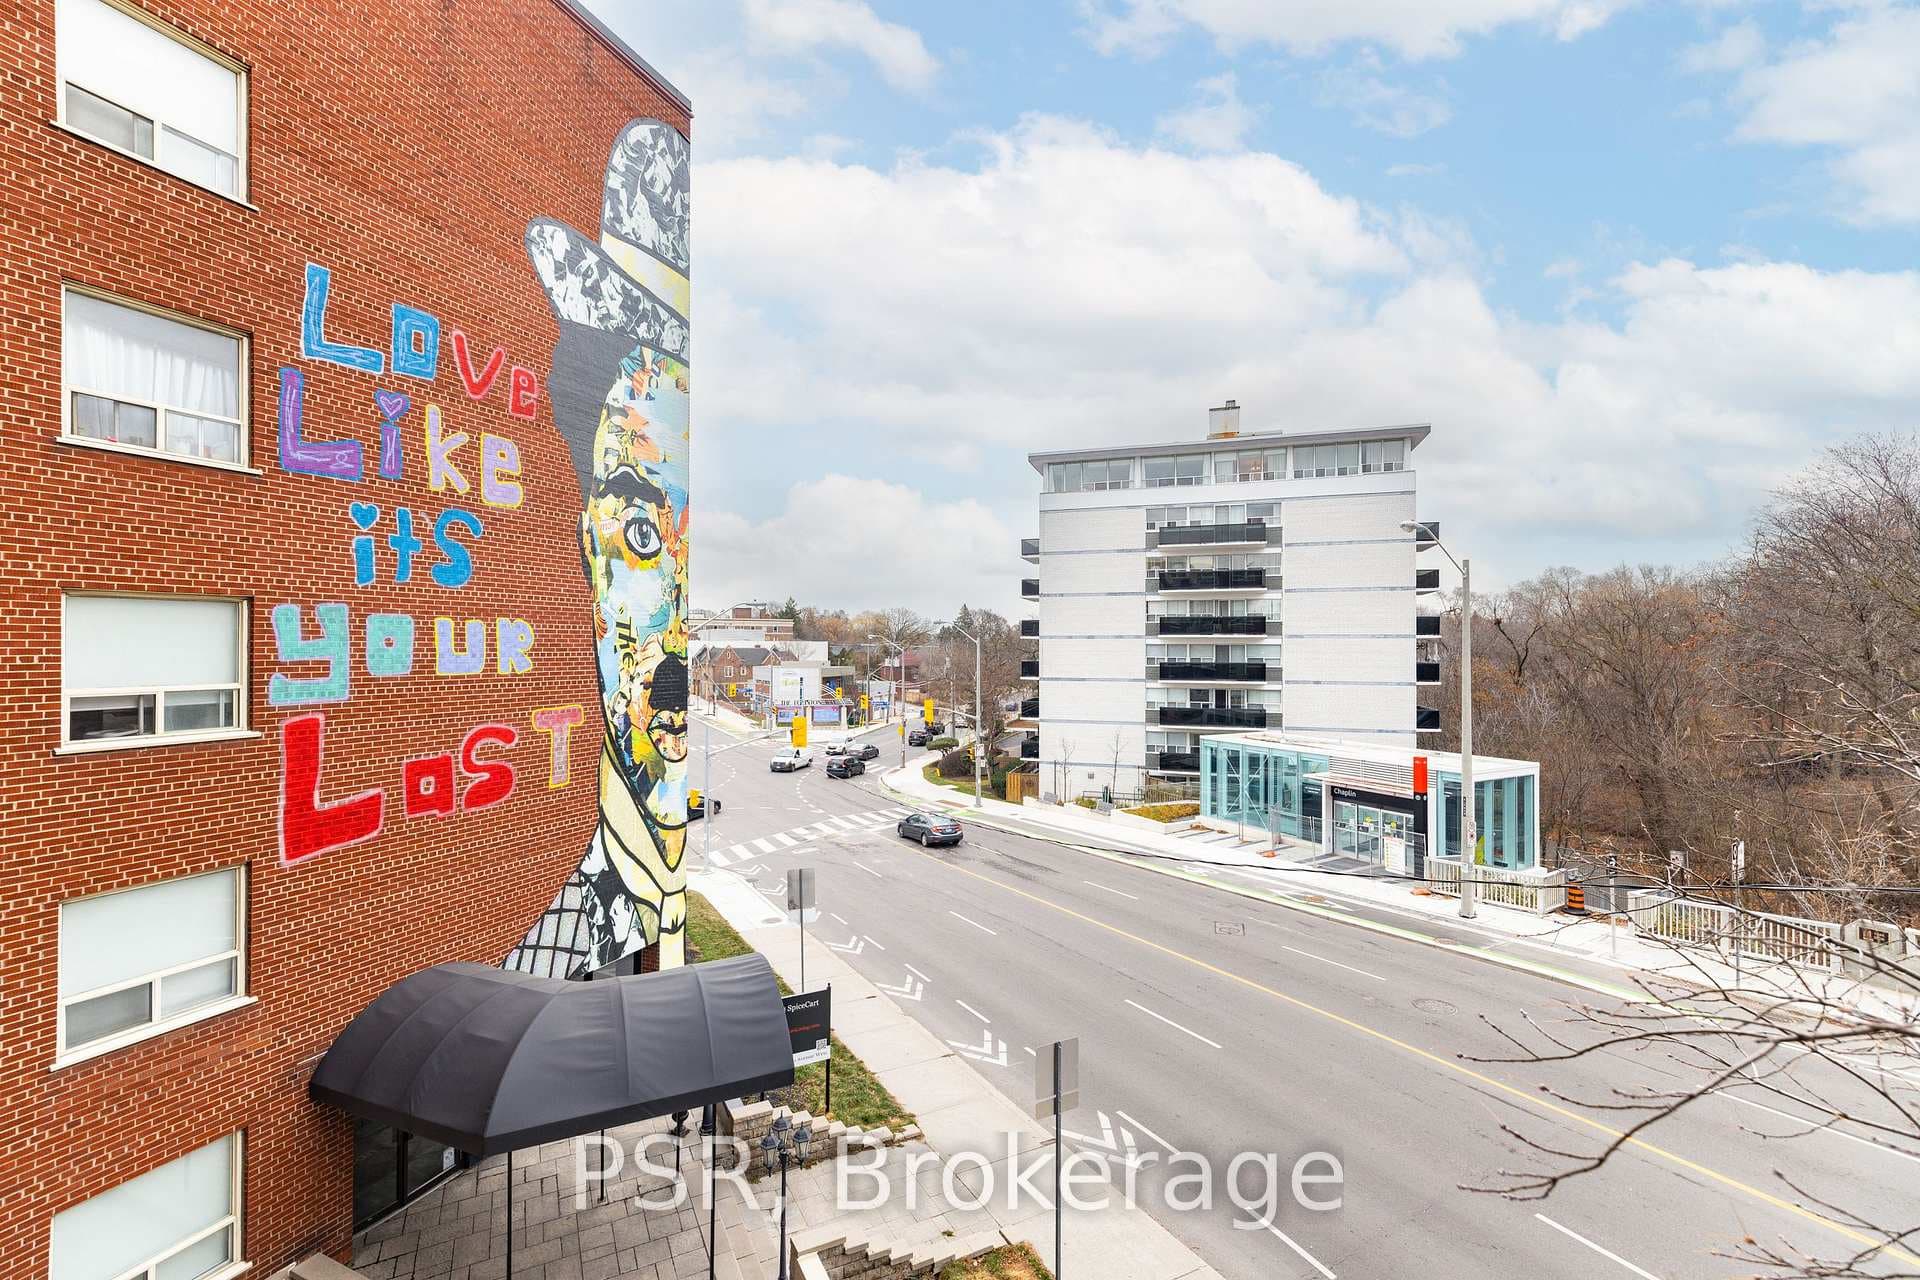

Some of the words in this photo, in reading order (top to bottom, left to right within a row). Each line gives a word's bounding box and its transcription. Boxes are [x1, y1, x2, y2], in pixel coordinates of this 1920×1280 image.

[279, 367, 524, 508] Like
[1334, 787, 1356, 798] Chaplin
[787, 1000, 819, 1012] SpiceCart
